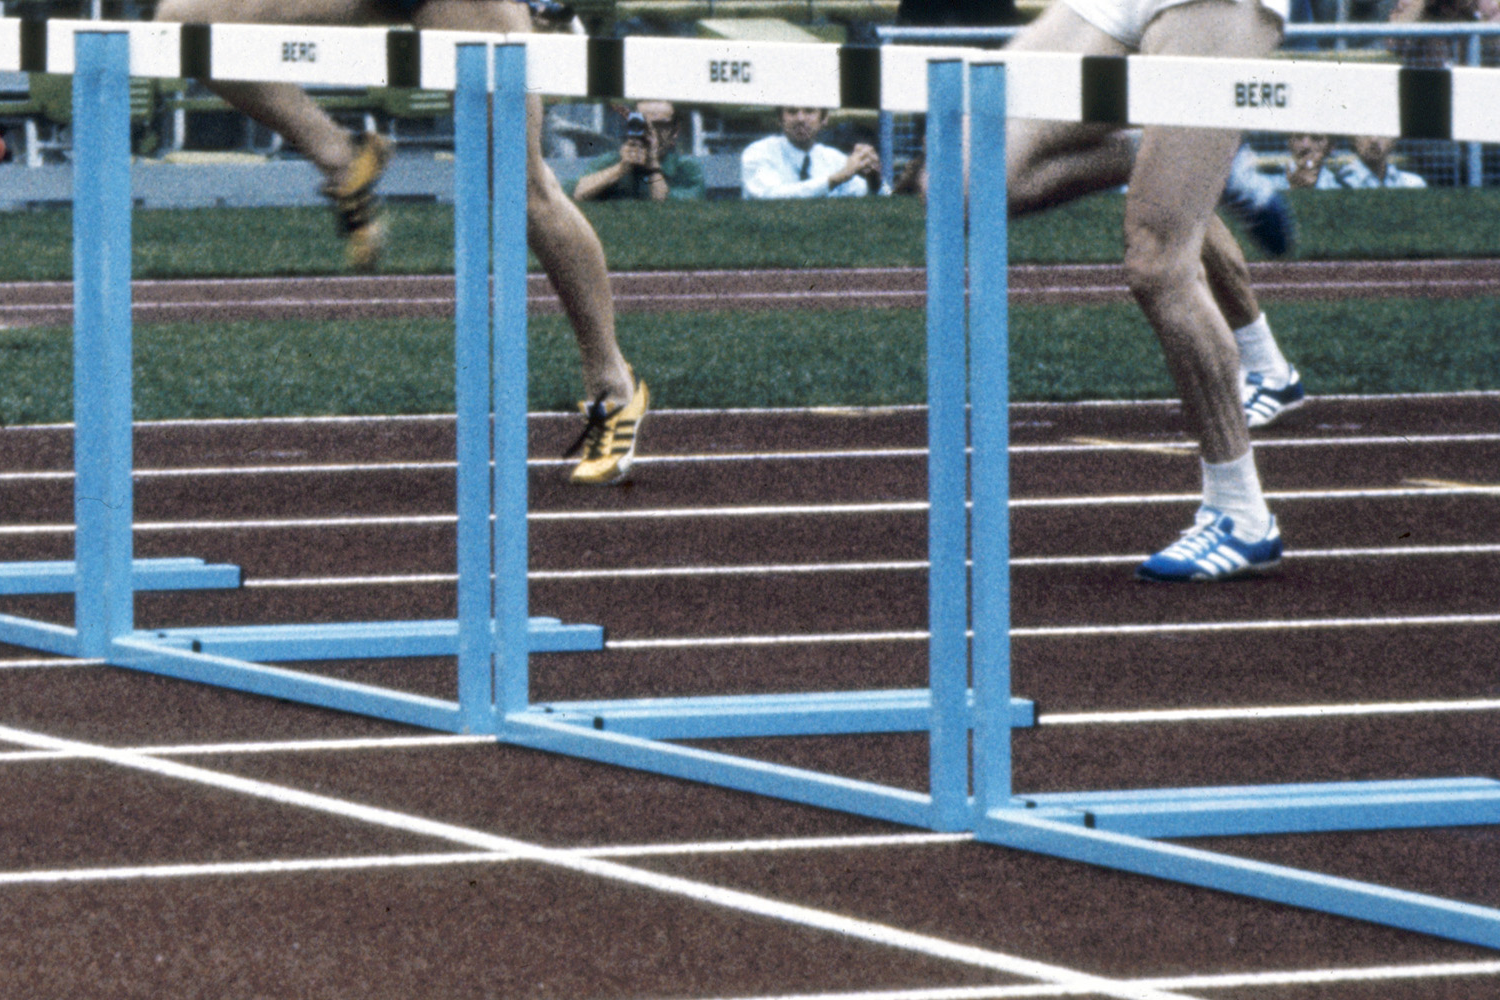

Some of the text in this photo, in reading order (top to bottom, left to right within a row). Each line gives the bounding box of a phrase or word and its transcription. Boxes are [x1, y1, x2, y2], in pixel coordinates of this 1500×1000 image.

[281, 41, 316, 62] BERG
[709, 60, 751, 83] BERG
[1235, 82, 1287, 108] BERG
